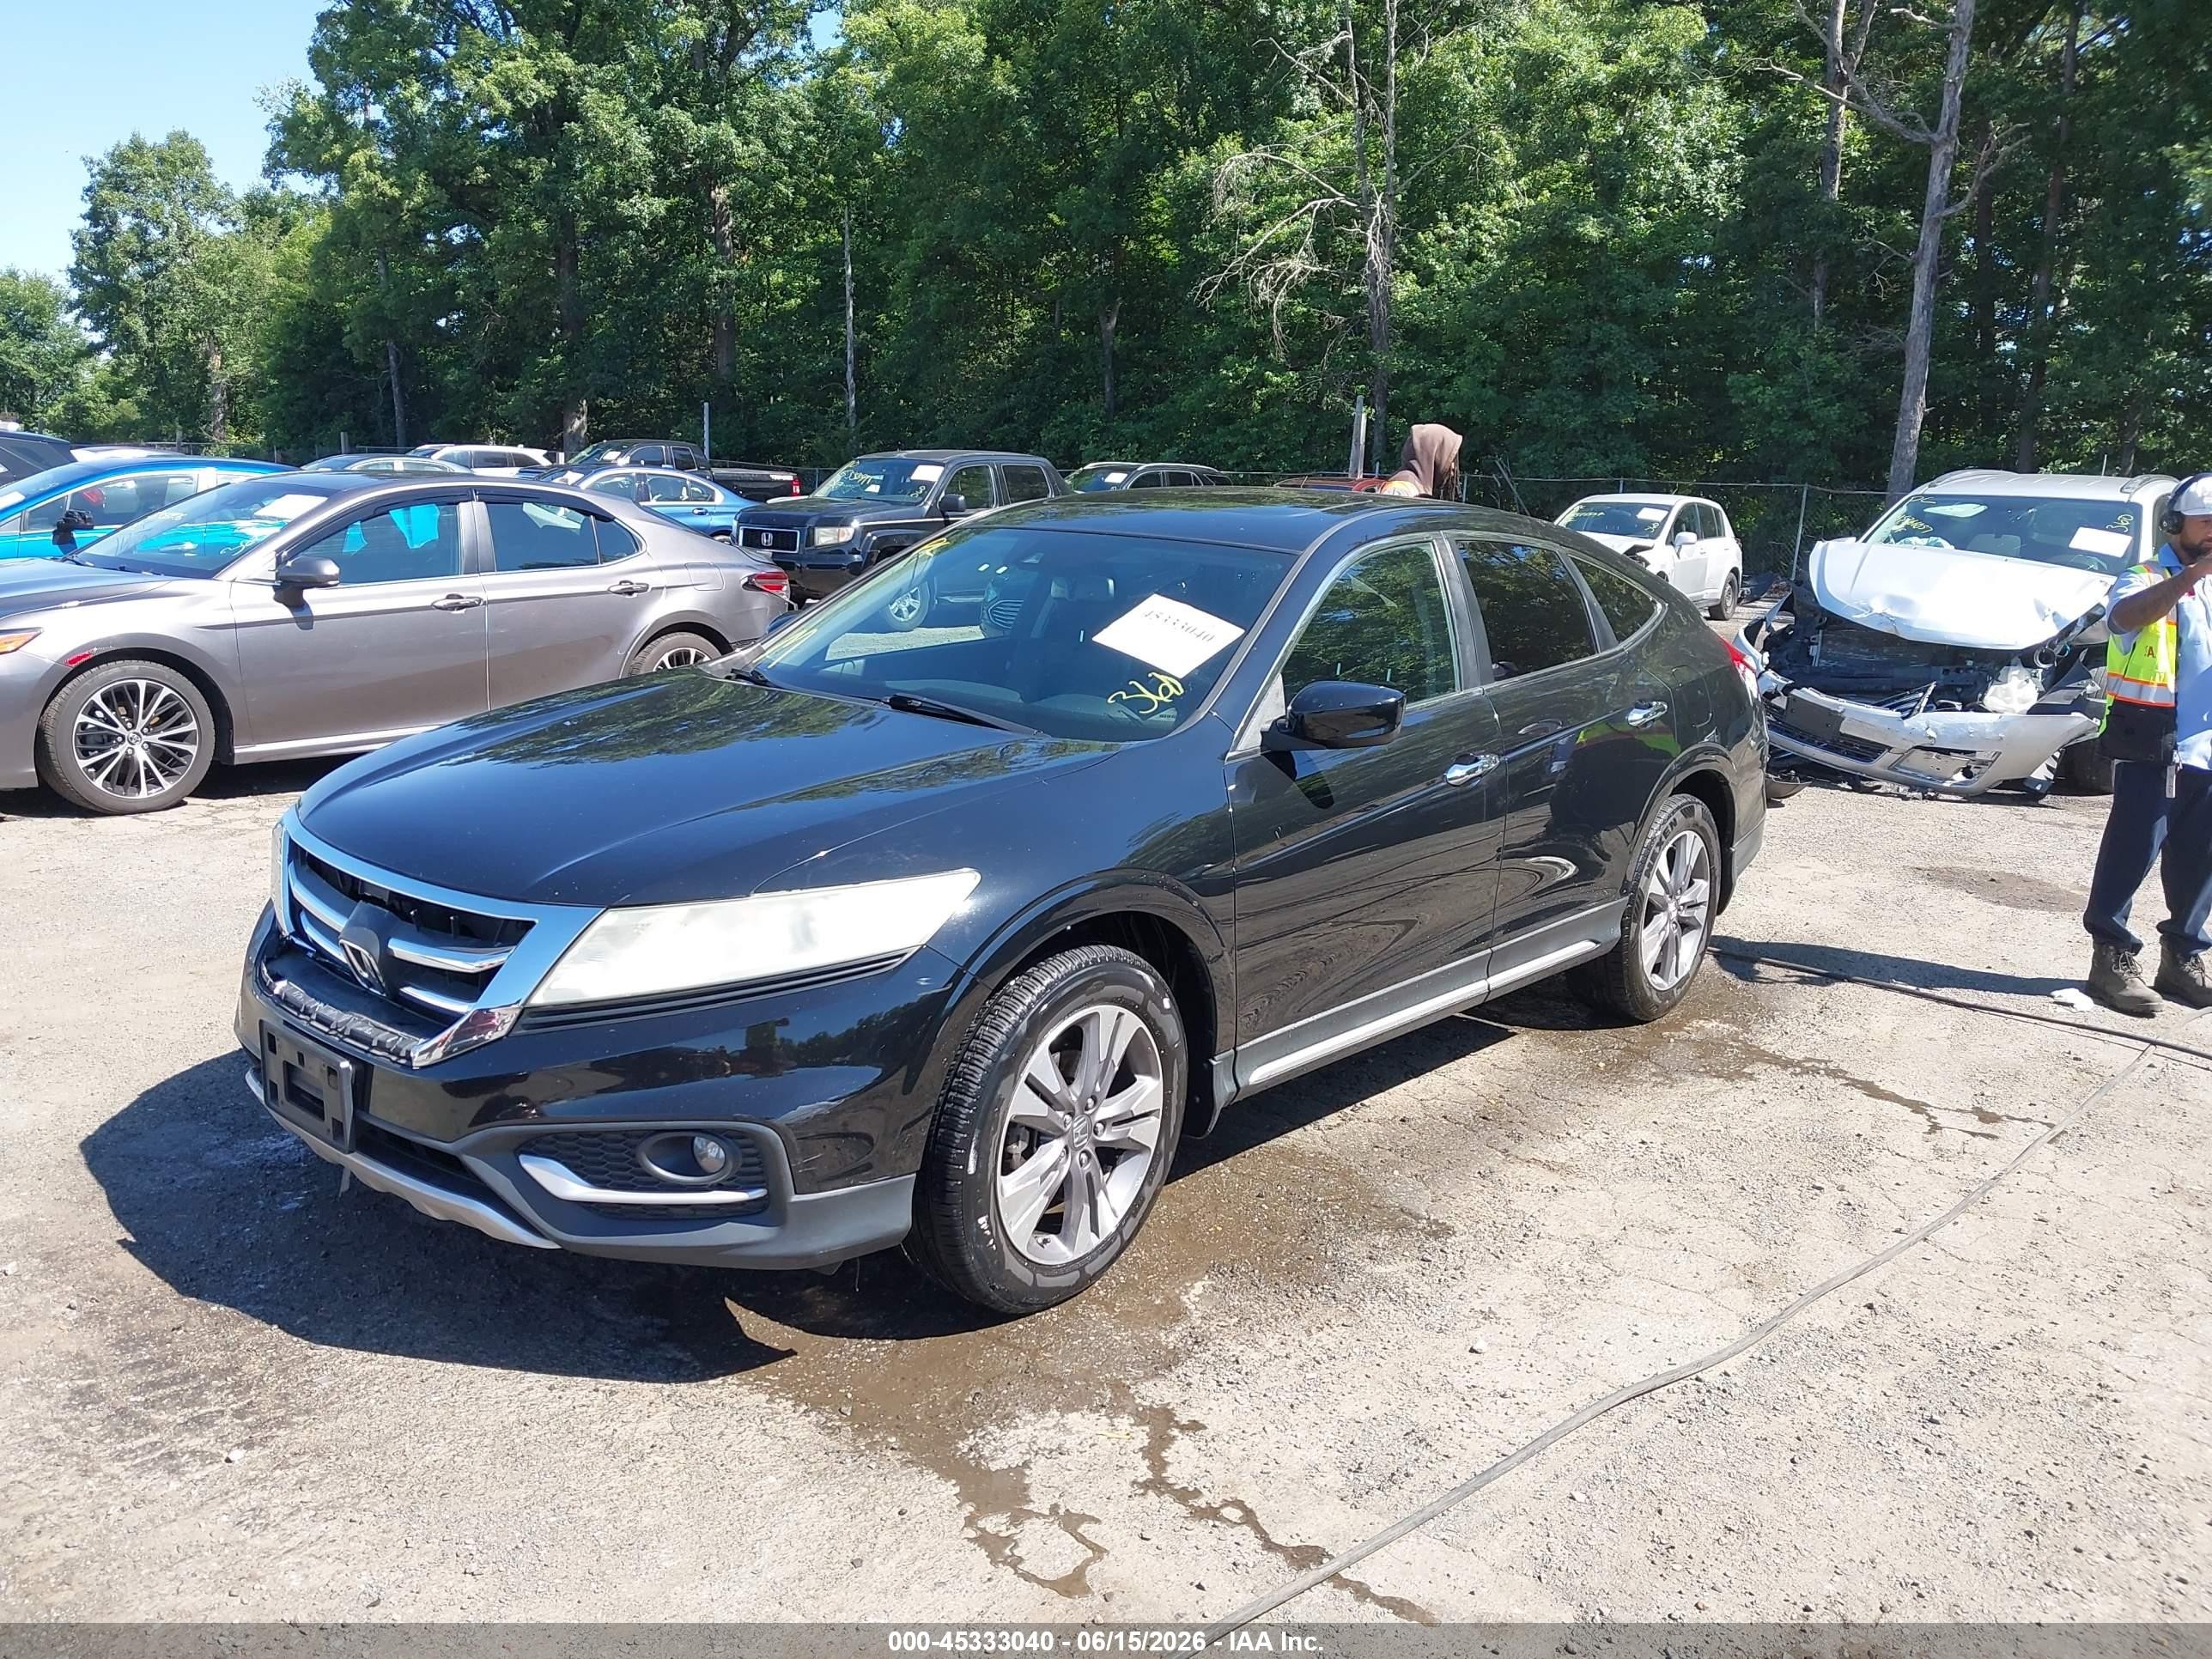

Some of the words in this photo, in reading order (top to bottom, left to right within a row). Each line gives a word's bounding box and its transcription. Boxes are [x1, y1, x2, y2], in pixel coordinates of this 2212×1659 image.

[2106, 514, 2134, 532] 360
[1107, 672, 1184, 714] 360
[1644, 818, 1678, 880] NEXEN
